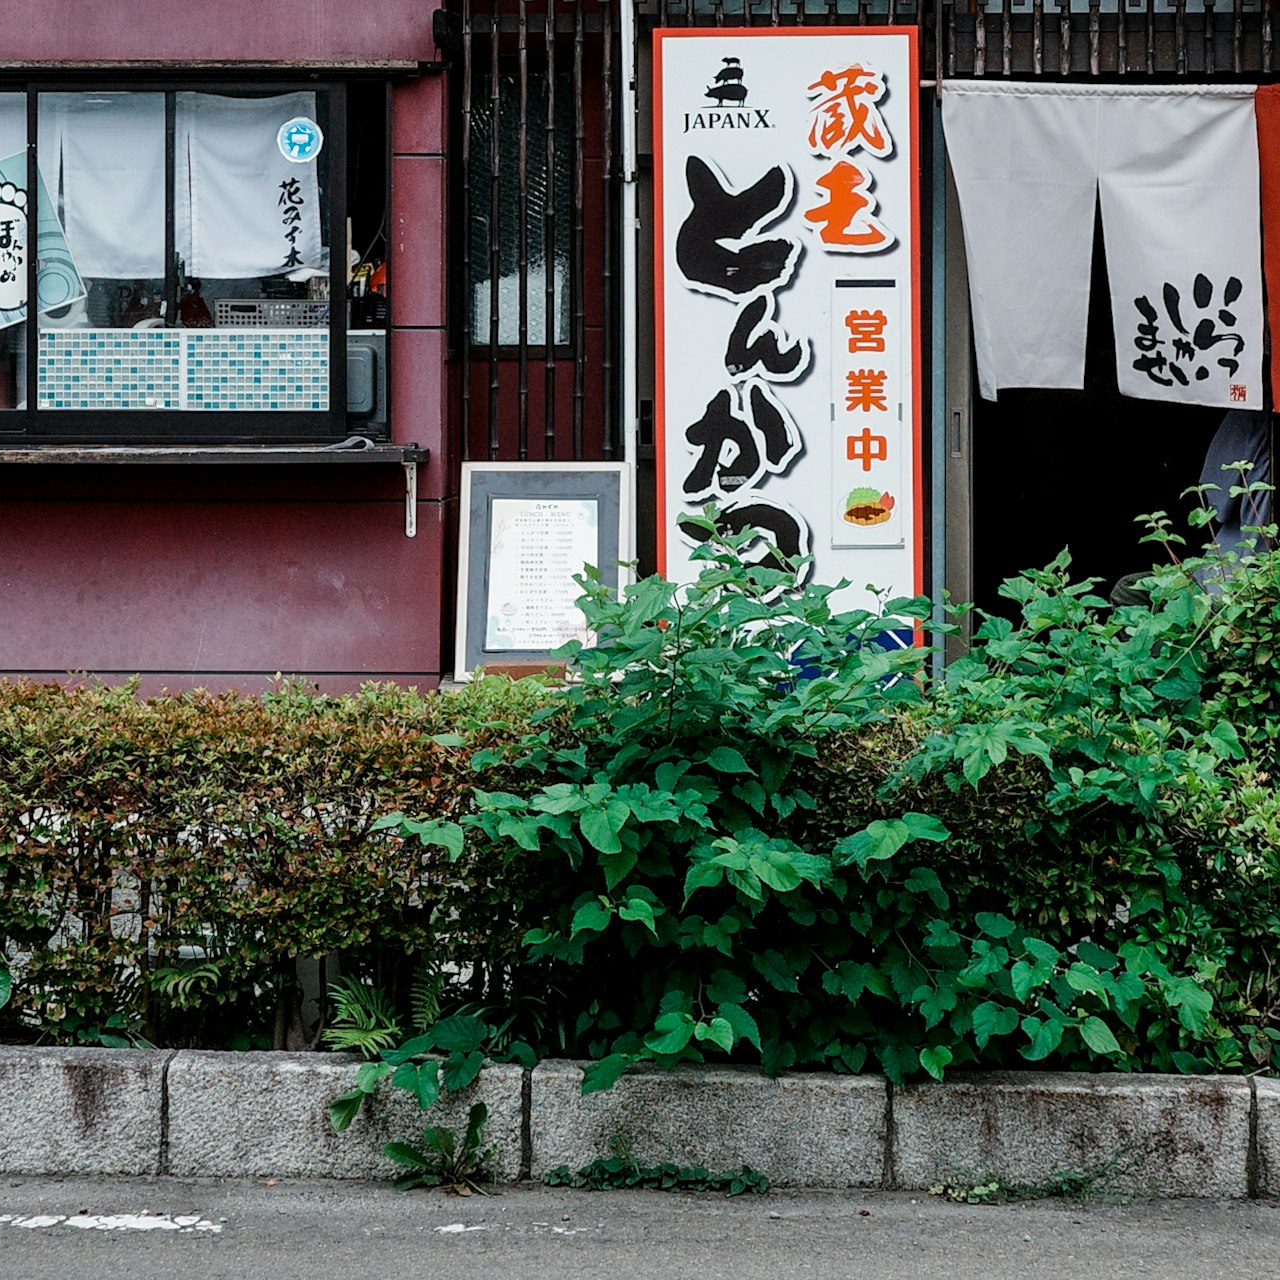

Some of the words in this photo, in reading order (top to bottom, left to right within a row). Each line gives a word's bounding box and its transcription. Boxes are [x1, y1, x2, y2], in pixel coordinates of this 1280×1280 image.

[277, 177, 305, 268] 花みず木
[804, 62, 886, 247] 蔵王
[844, 309, 889, 473] 営業中
